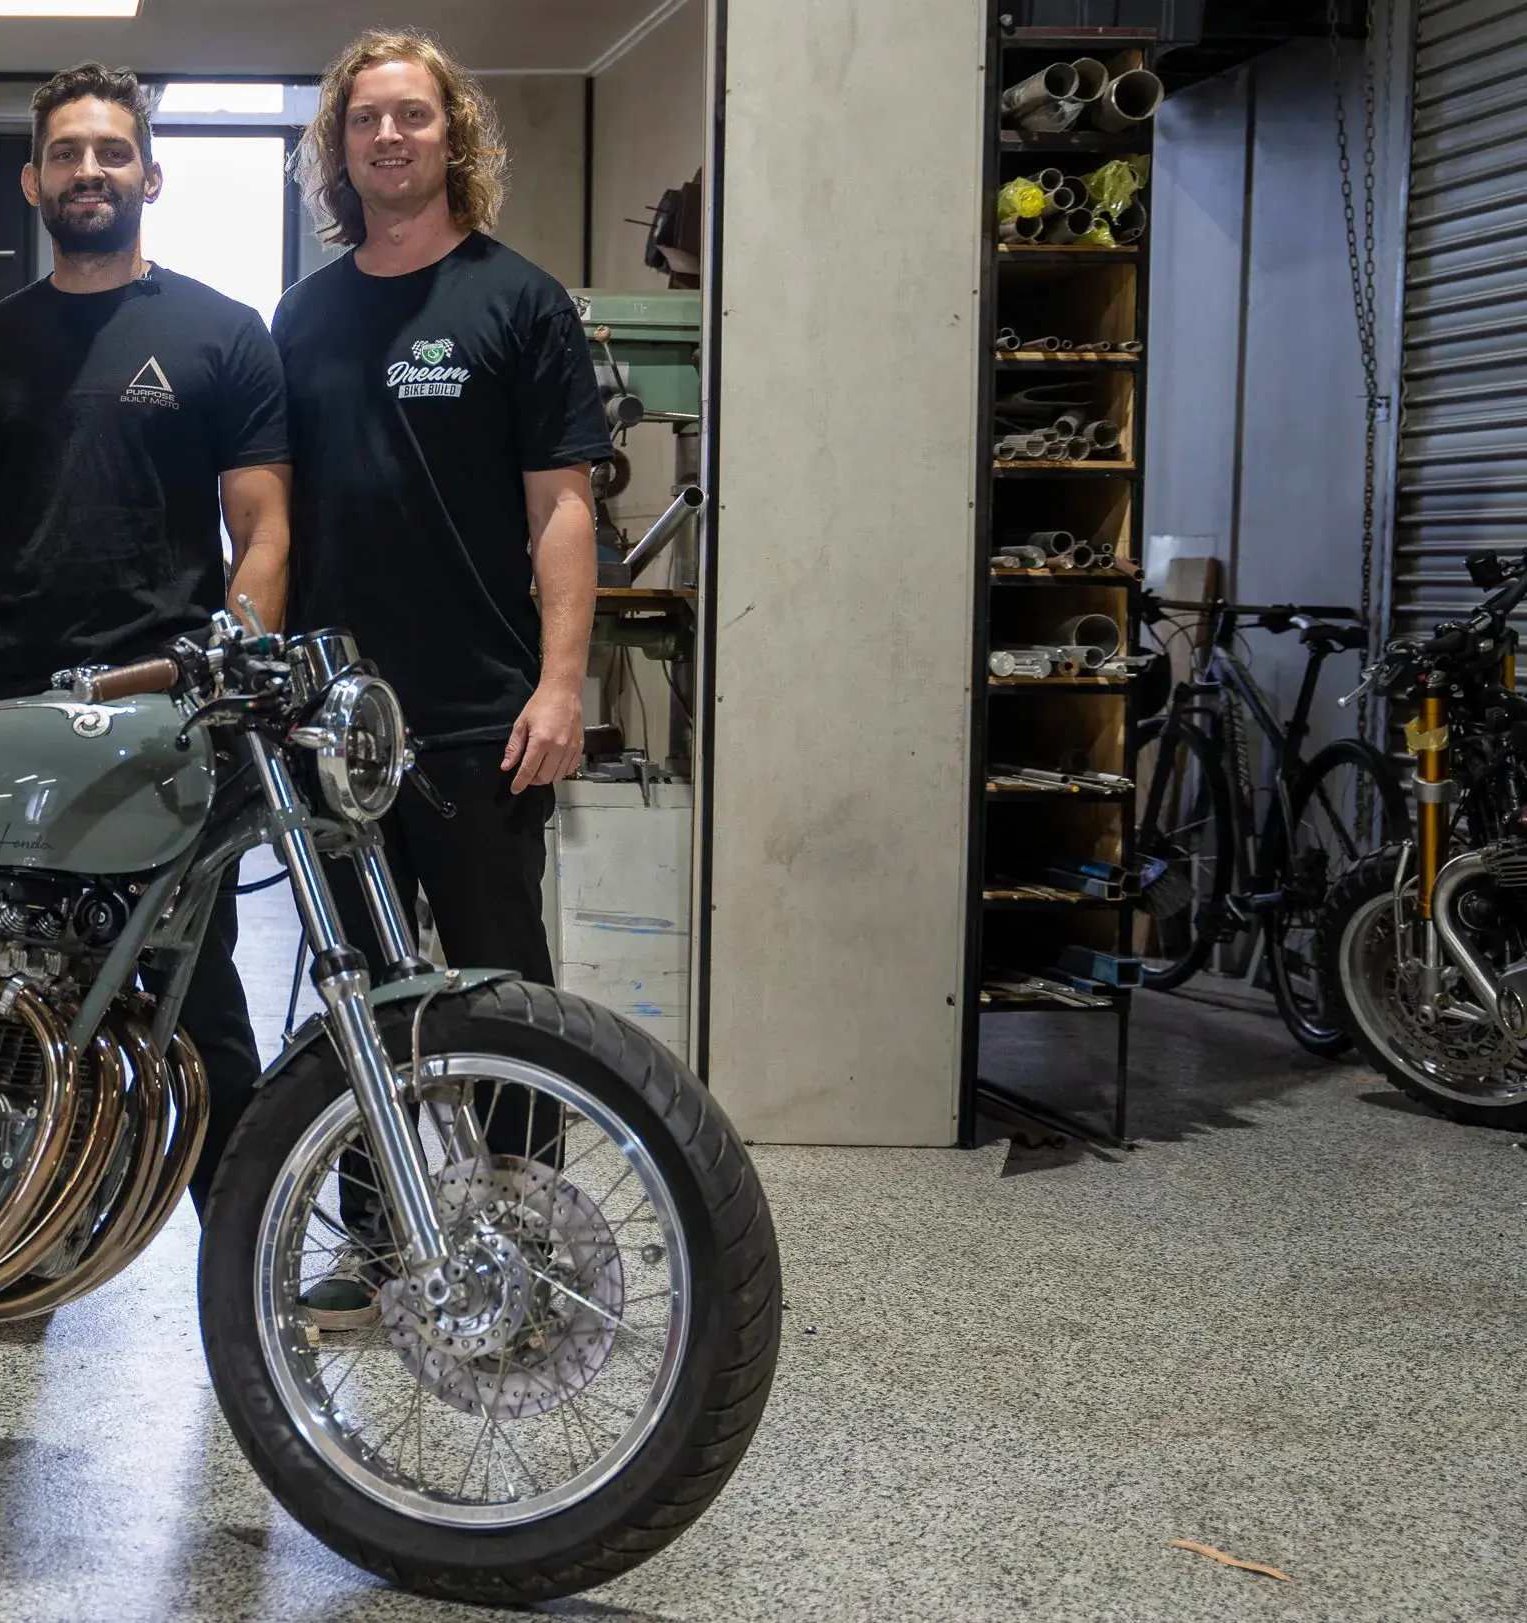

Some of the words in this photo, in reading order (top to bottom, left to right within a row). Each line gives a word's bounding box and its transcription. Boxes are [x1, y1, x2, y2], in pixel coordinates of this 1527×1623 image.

[386, 361, 471, 387] Dream
[126, 388, 175, 402] PURPOSE
[404, 386, 426, 397] BIKE
[428, 384, 457, 396] BUILD
[149, 398, 180, 410] MOTO
